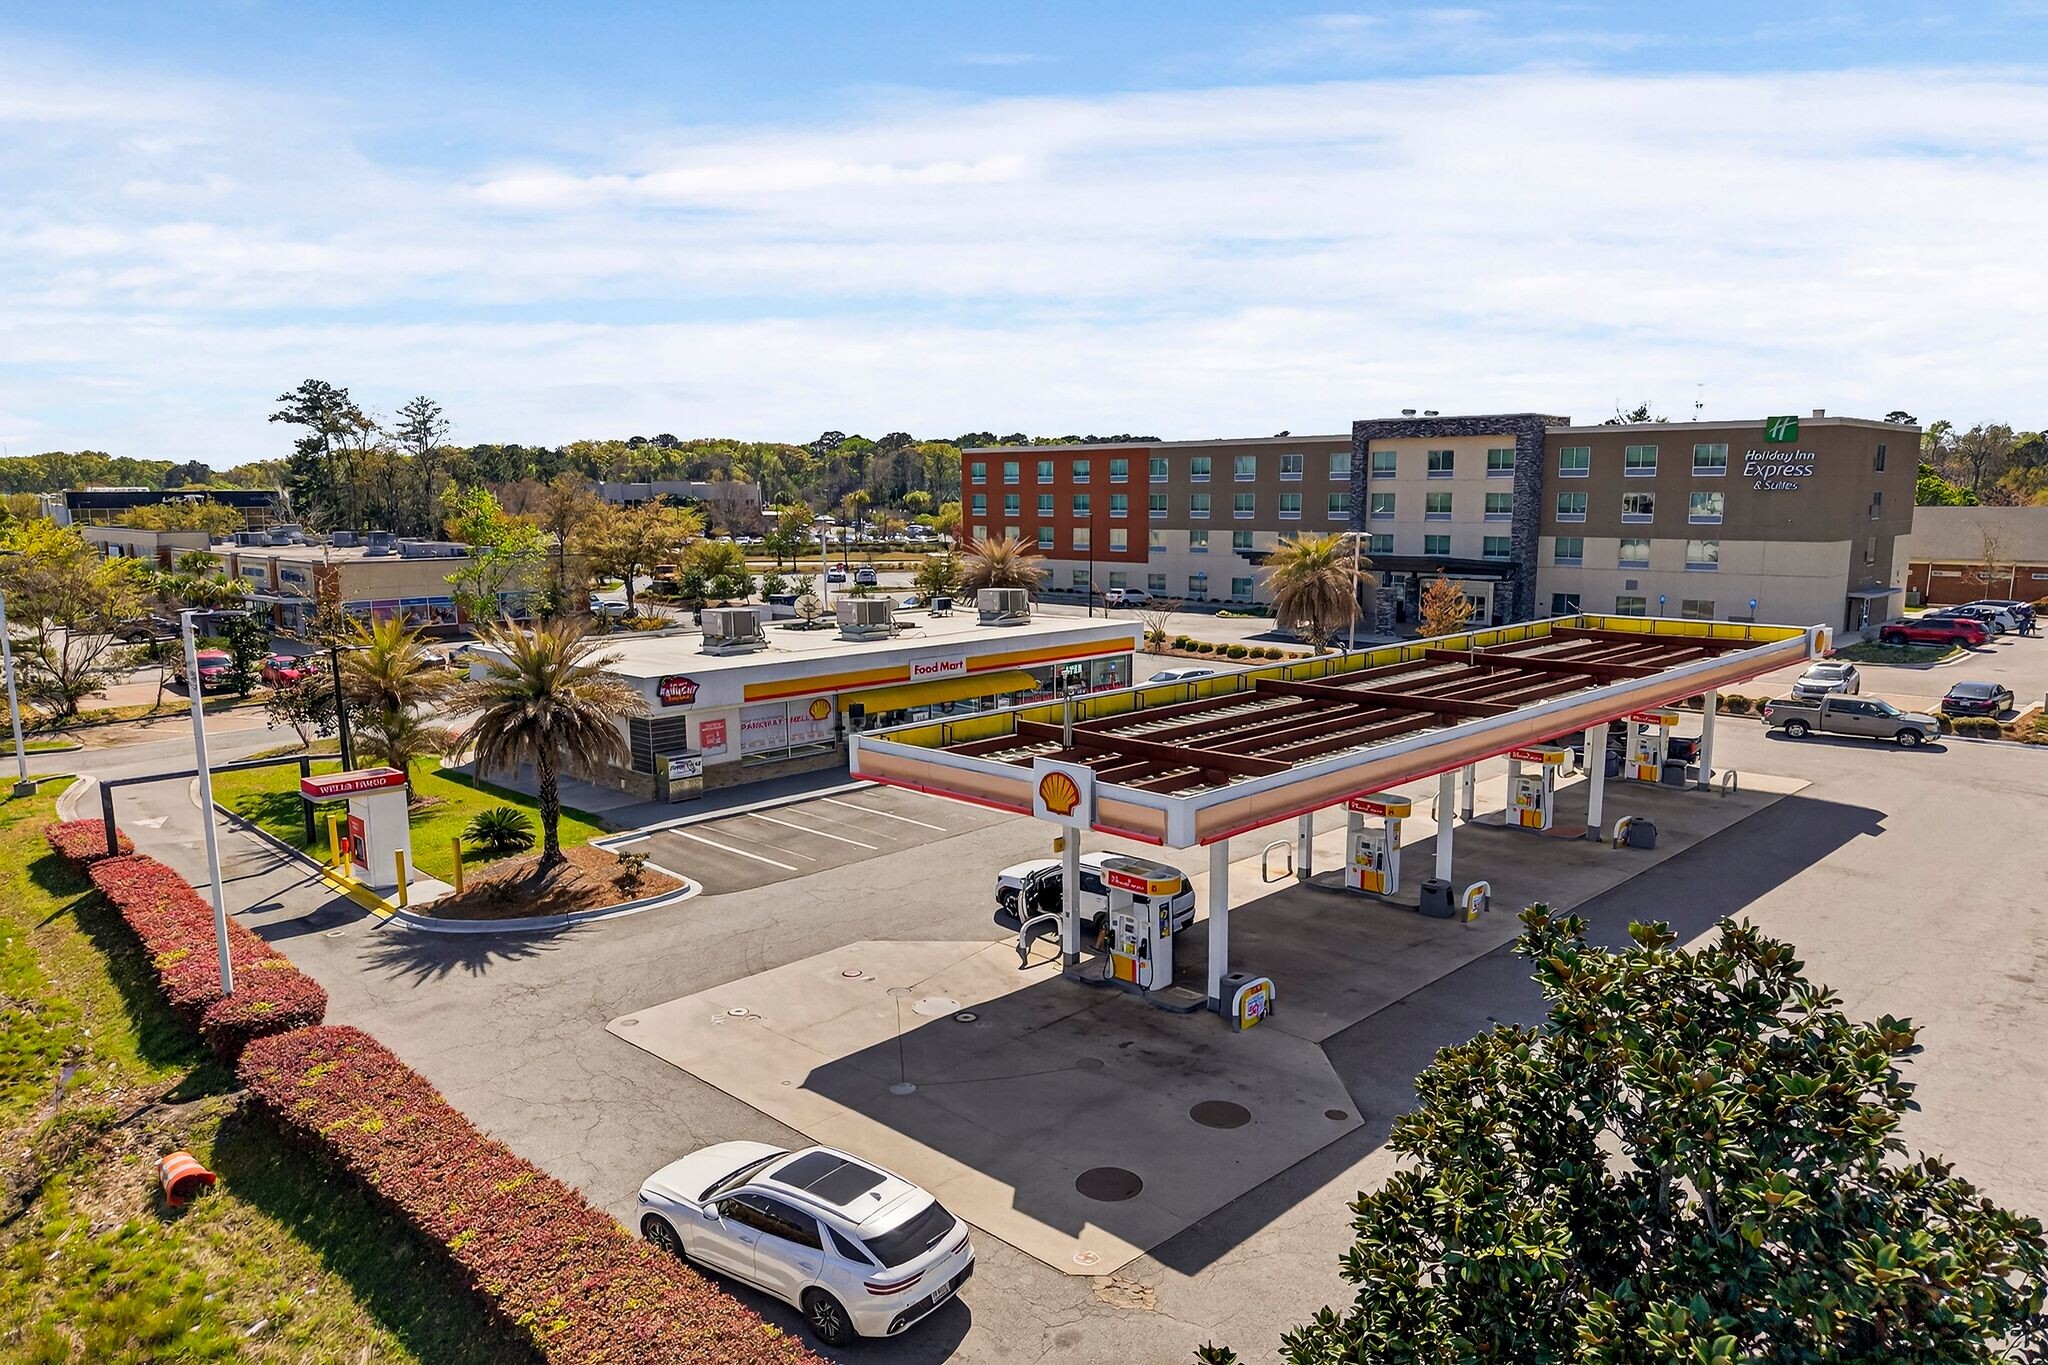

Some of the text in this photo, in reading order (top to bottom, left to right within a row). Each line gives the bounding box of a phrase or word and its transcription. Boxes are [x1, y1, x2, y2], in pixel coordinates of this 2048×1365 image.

[1745, 449, 1815, 463] Holiday Inn
[1743, 461, 1814, 480] Express
[1753, 480, 1762, 490] &
[914, 660, 964, 675] Food Mart
